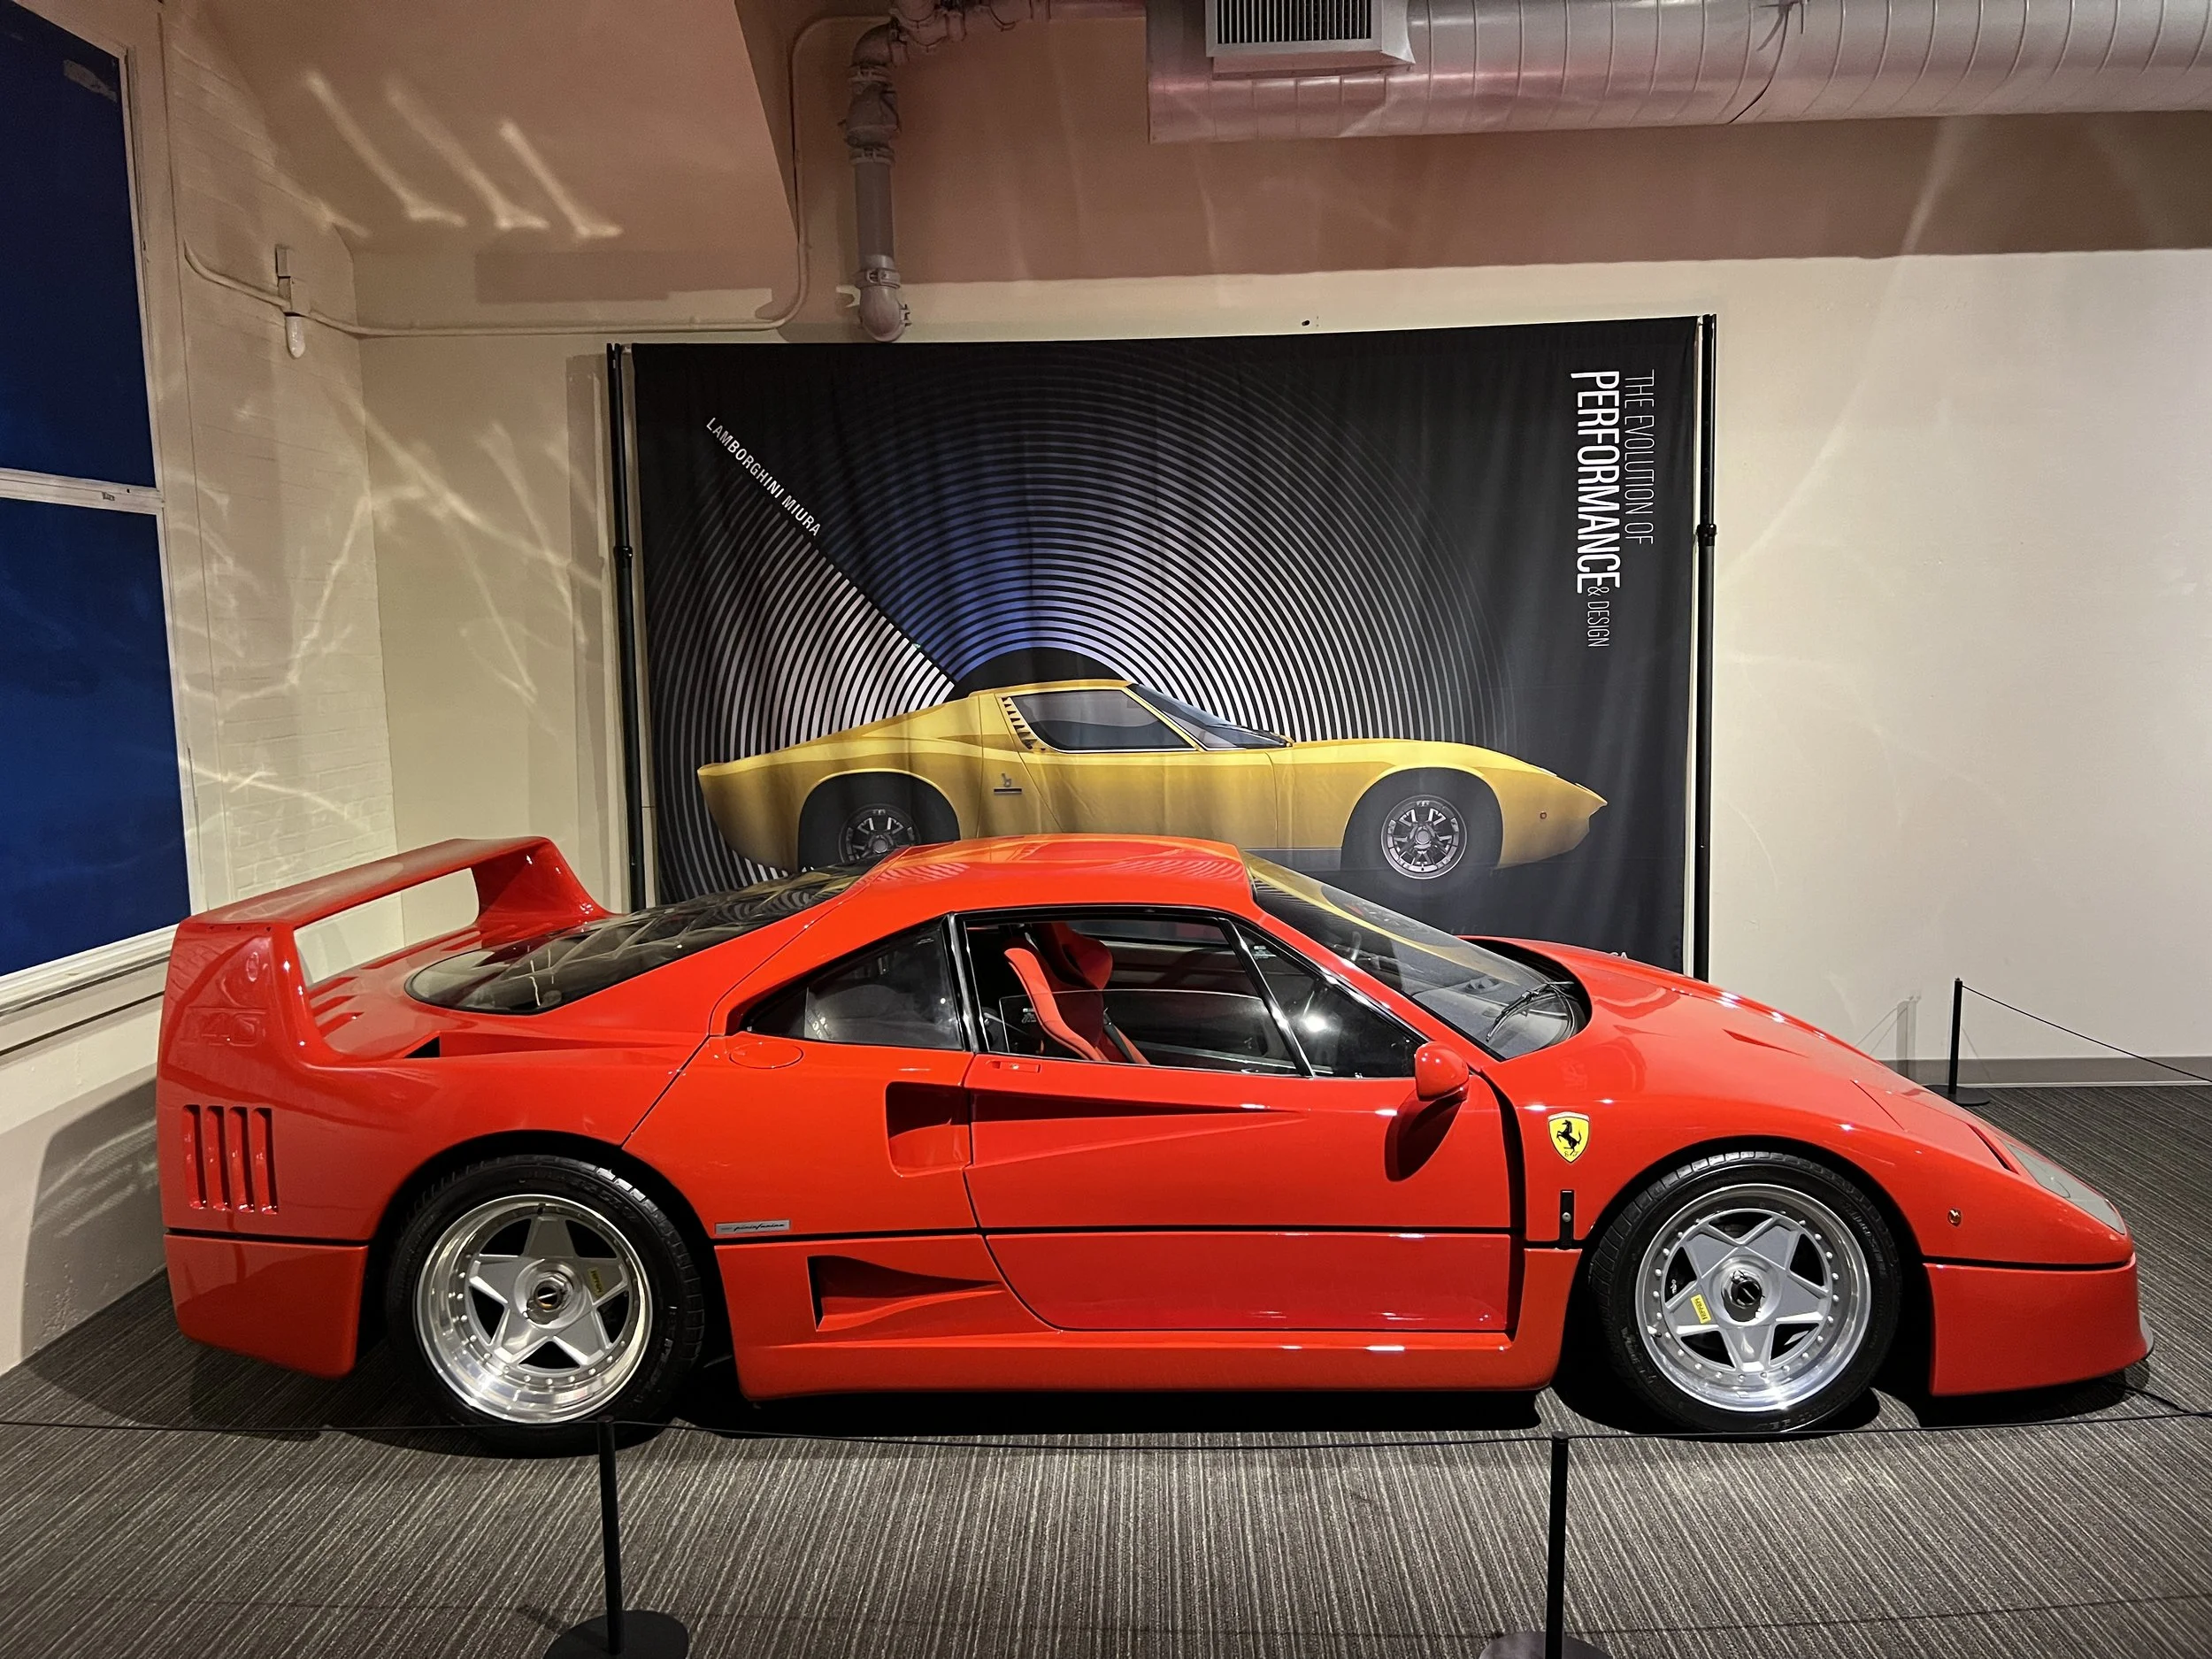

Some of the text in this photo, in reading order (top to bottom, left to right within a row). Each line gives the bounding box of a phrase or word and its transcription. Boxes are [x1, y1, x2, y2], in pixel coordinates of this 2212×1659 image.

[706, 418, 821, 536] LAMBORGHINI MIURA
[1571, 371, 1621, 648] PERFORMANCE & DESIGN
[1624, 369, 1655, 544] THE EVOLUTION OF
